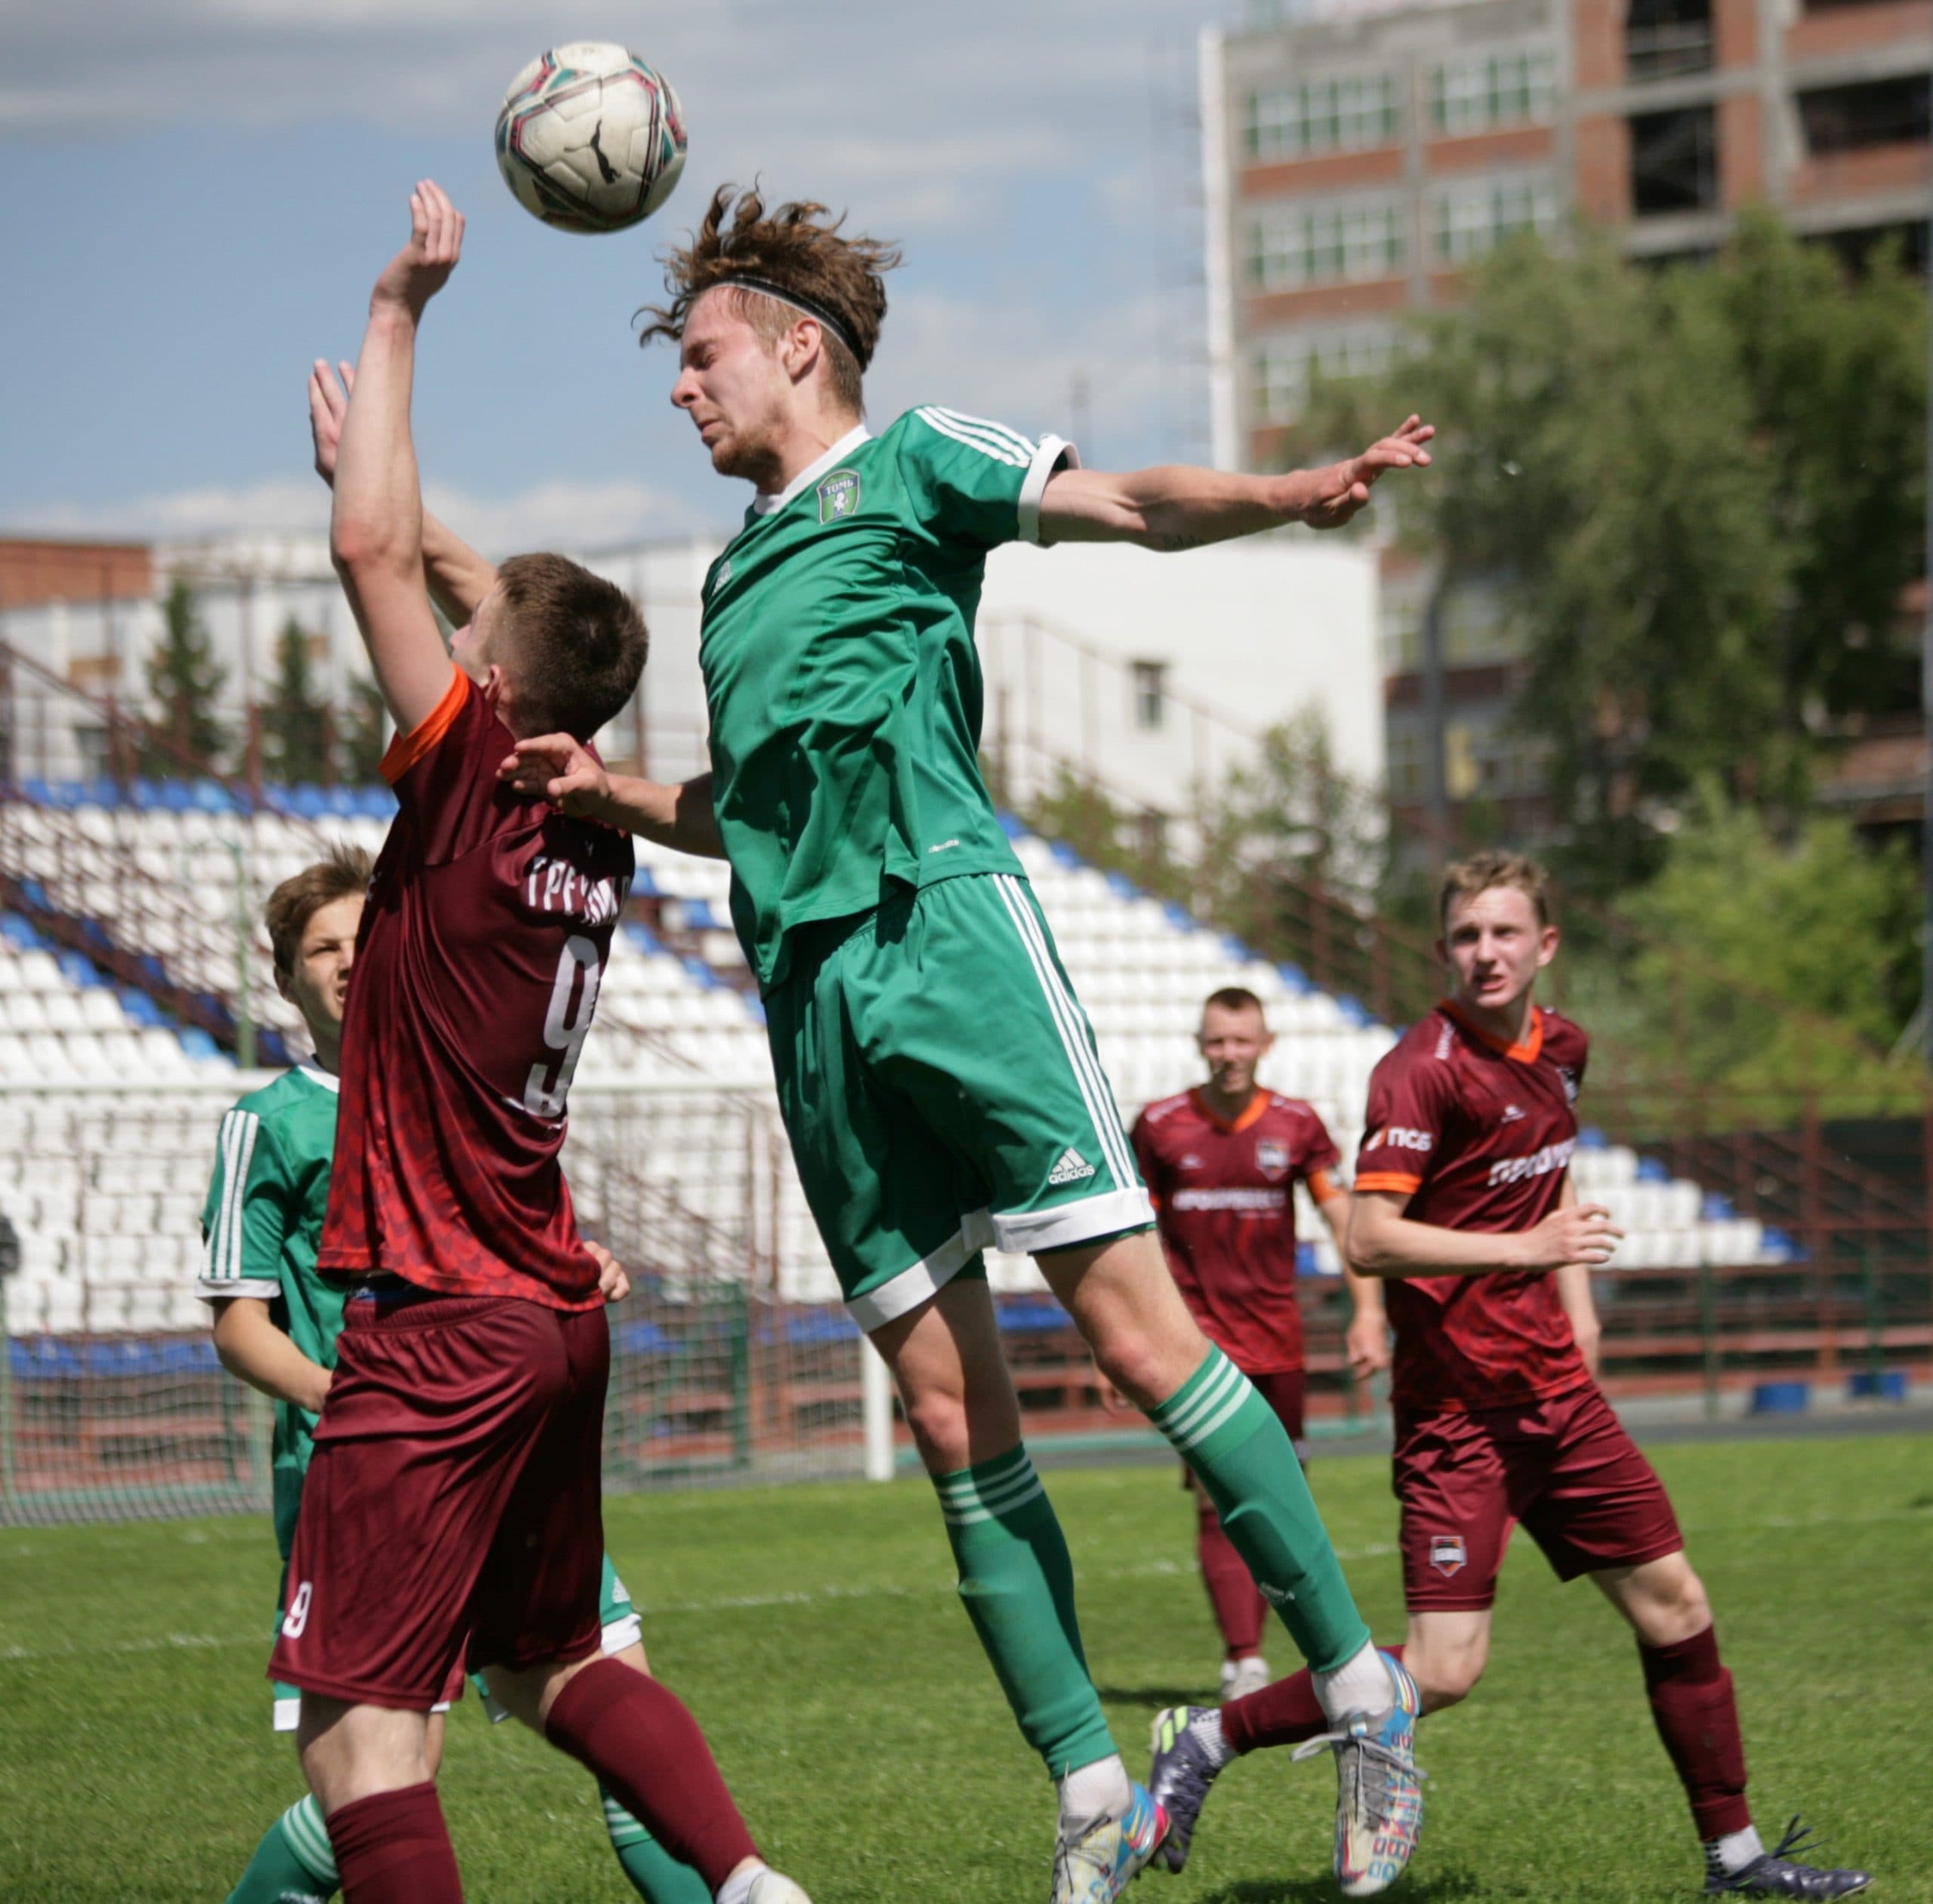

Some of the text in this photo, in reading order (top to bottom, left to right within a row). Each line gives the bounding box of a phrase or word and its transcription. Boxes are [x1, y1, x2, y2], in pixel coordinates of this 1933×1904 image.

[524, 935, 599, 1118] 9
[1049, 1165, 1095, 1184] adidas
[282, 1581, 313, 1640] 9
